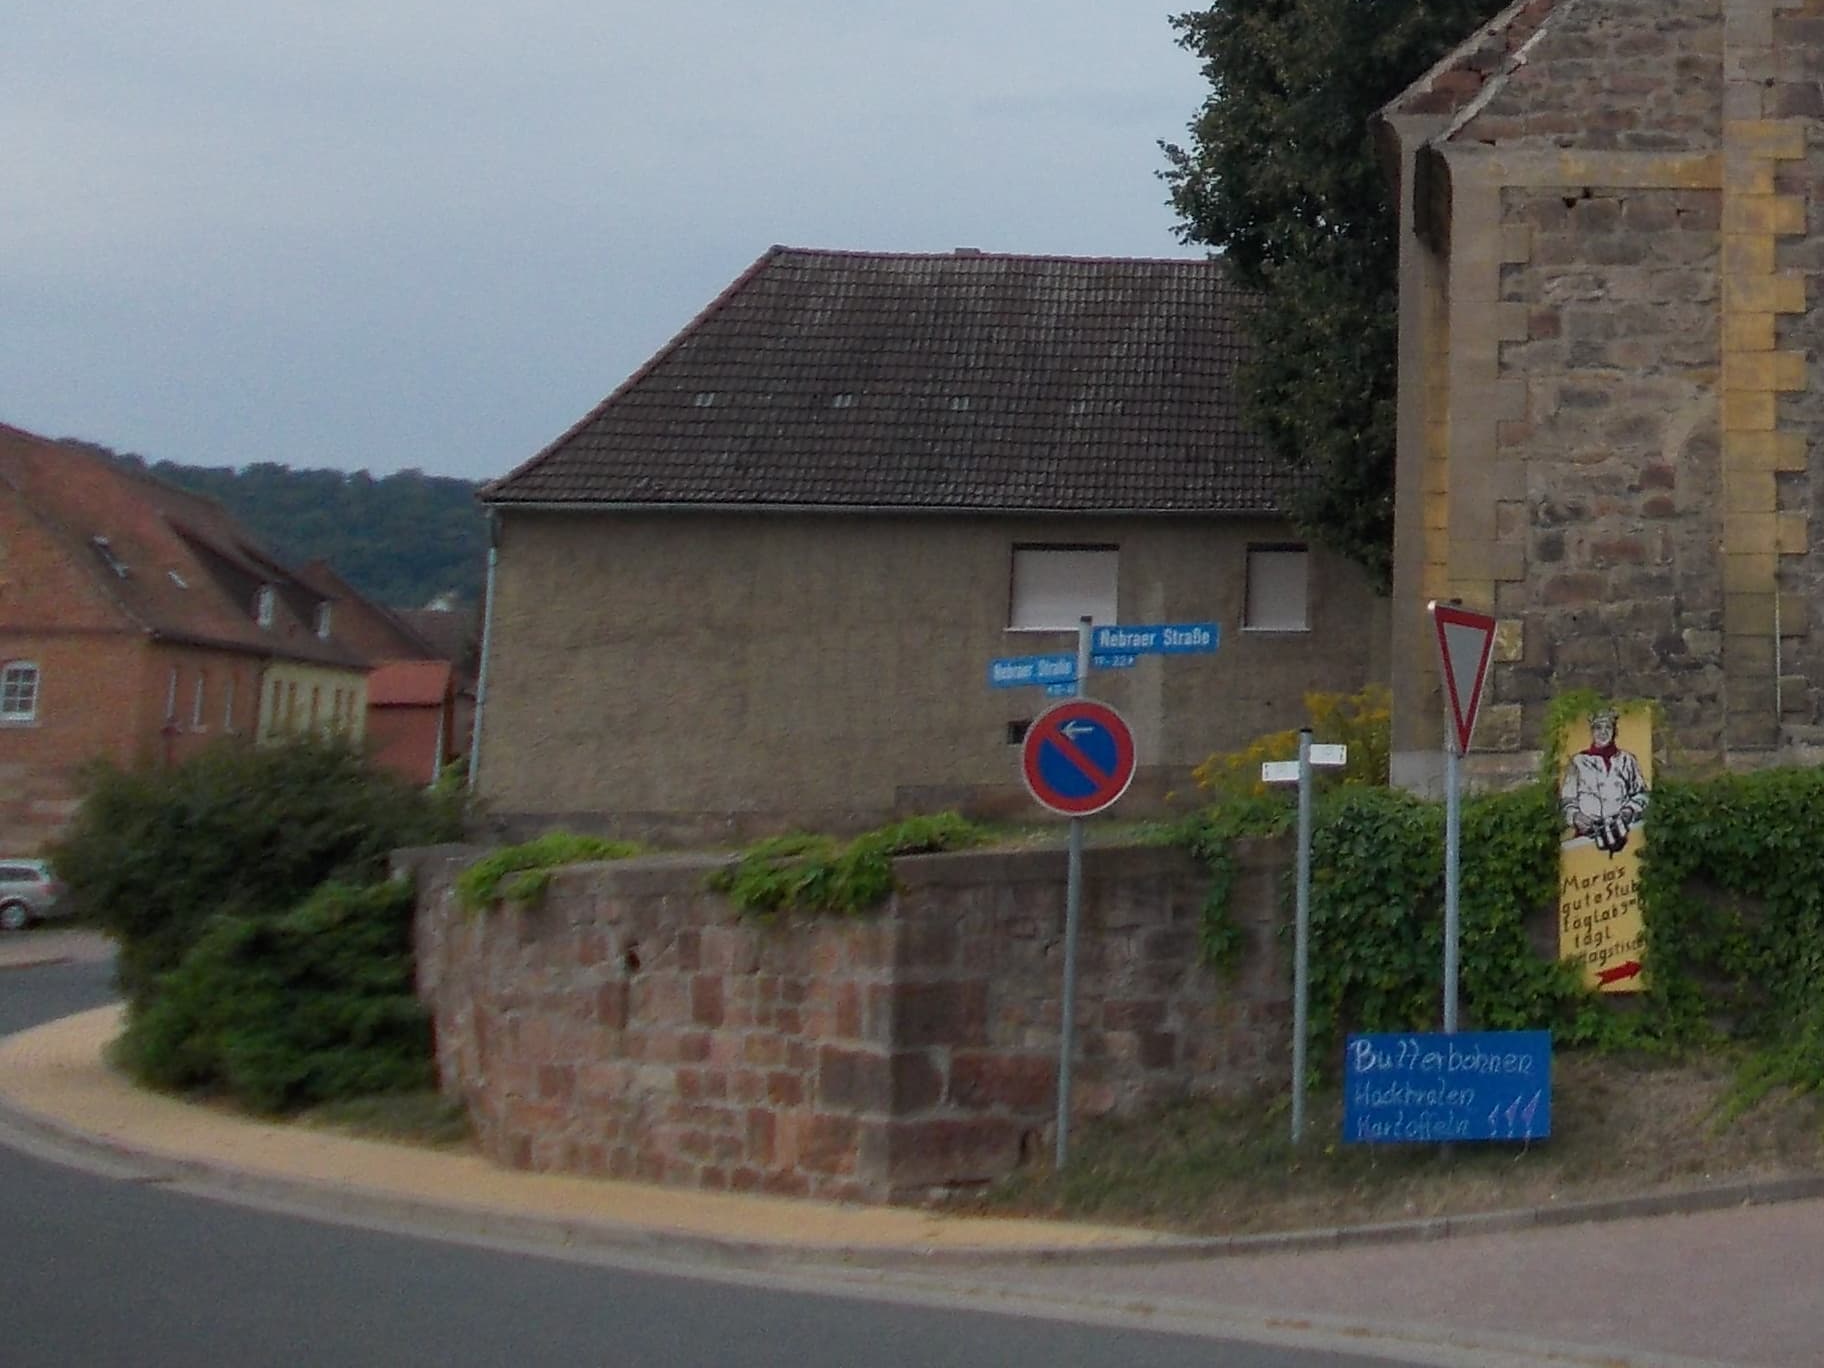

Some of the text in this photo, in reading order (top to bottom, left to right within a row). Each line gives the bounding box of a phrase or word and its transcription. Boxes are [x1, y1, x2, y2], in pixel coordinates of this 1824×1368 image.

[1099, 627, 1211, 648] Nebraer Straße
[1350, 1038, 1534, 1073] Butterbohnen
